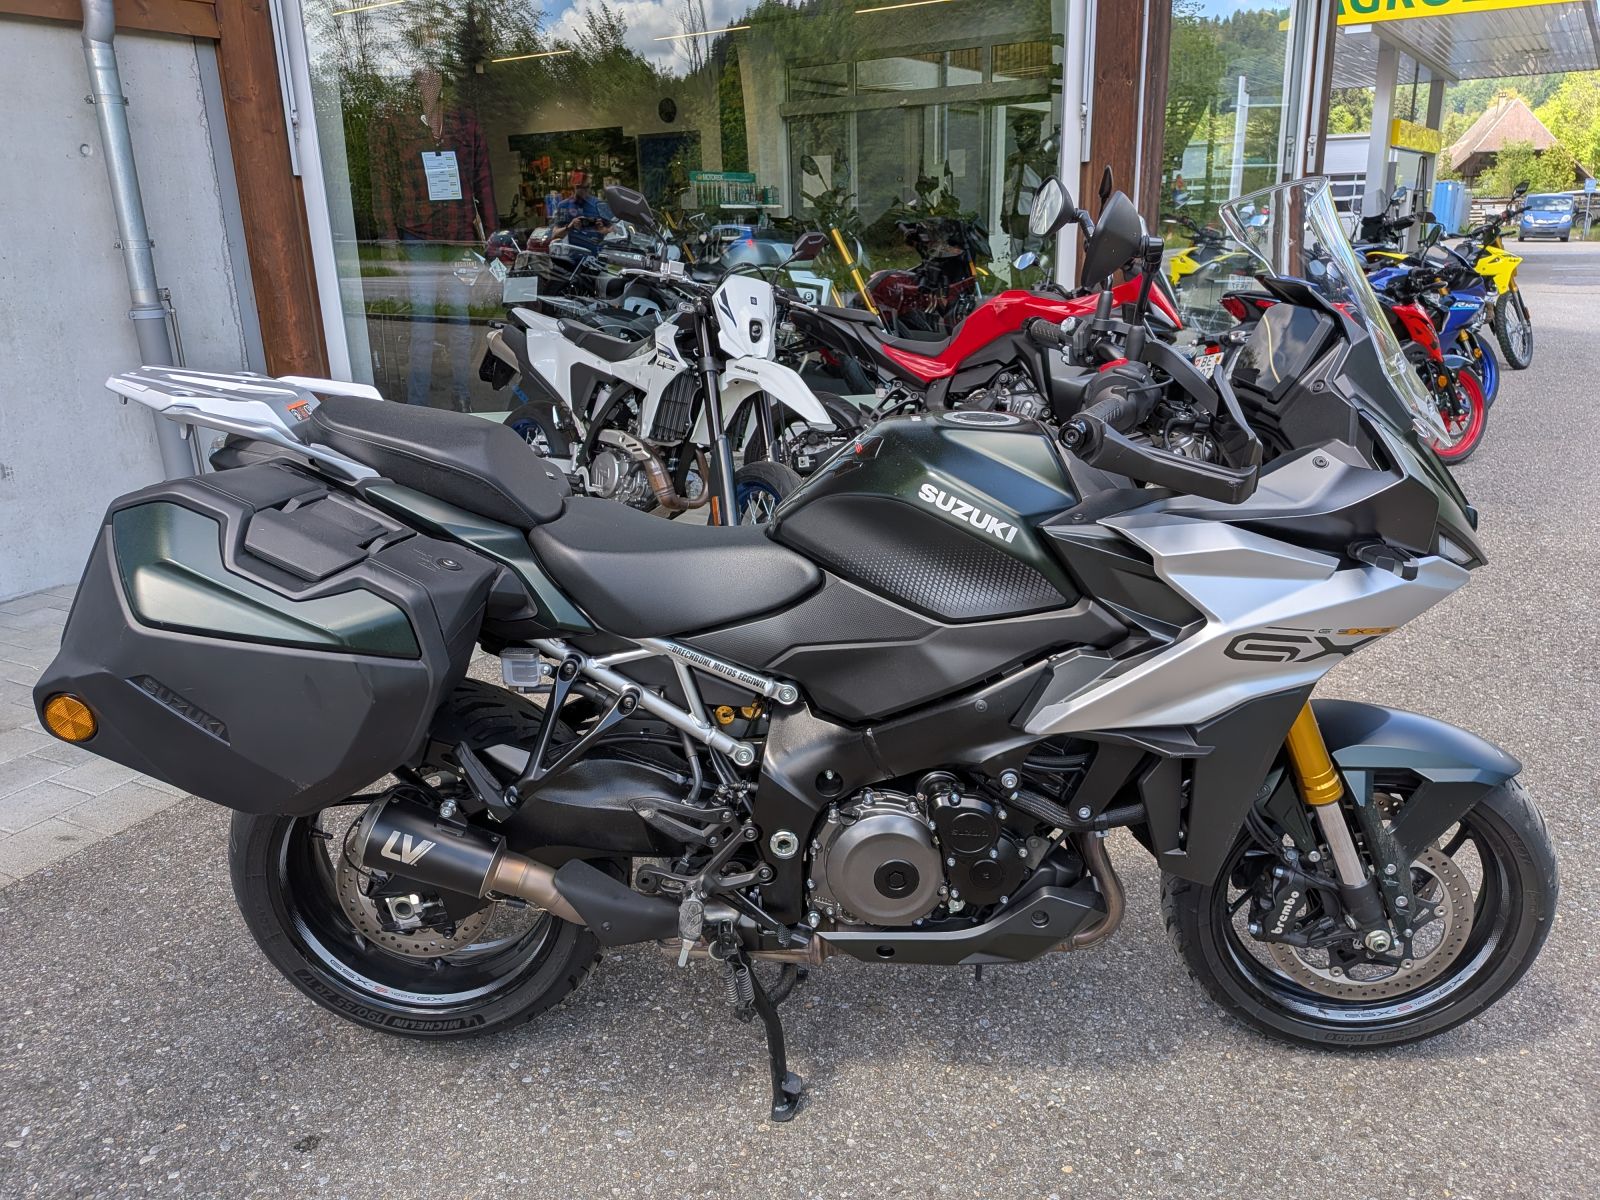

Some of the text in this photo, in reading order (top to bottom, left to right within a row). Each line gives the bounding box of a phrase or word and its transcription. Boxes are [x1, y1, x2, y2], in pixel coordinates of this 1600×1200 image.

[1200, 356, 1214, 367] BE
[918, 483, 1018, 543] SUZUKI
[1223, 632, 1382, 662] GX
[712, 662, 738, 678] MOTOS
[738, 673, 767, 690] EGGIWIL
[140, 677, 225, 737] SUZUKI
[380, 830, 436, 866] LV
[1271, 891, 1300, 934] brembo
[336, 997, 384, 1024] 190/55
[391, 1017, 461, 1031] MICHELIN
